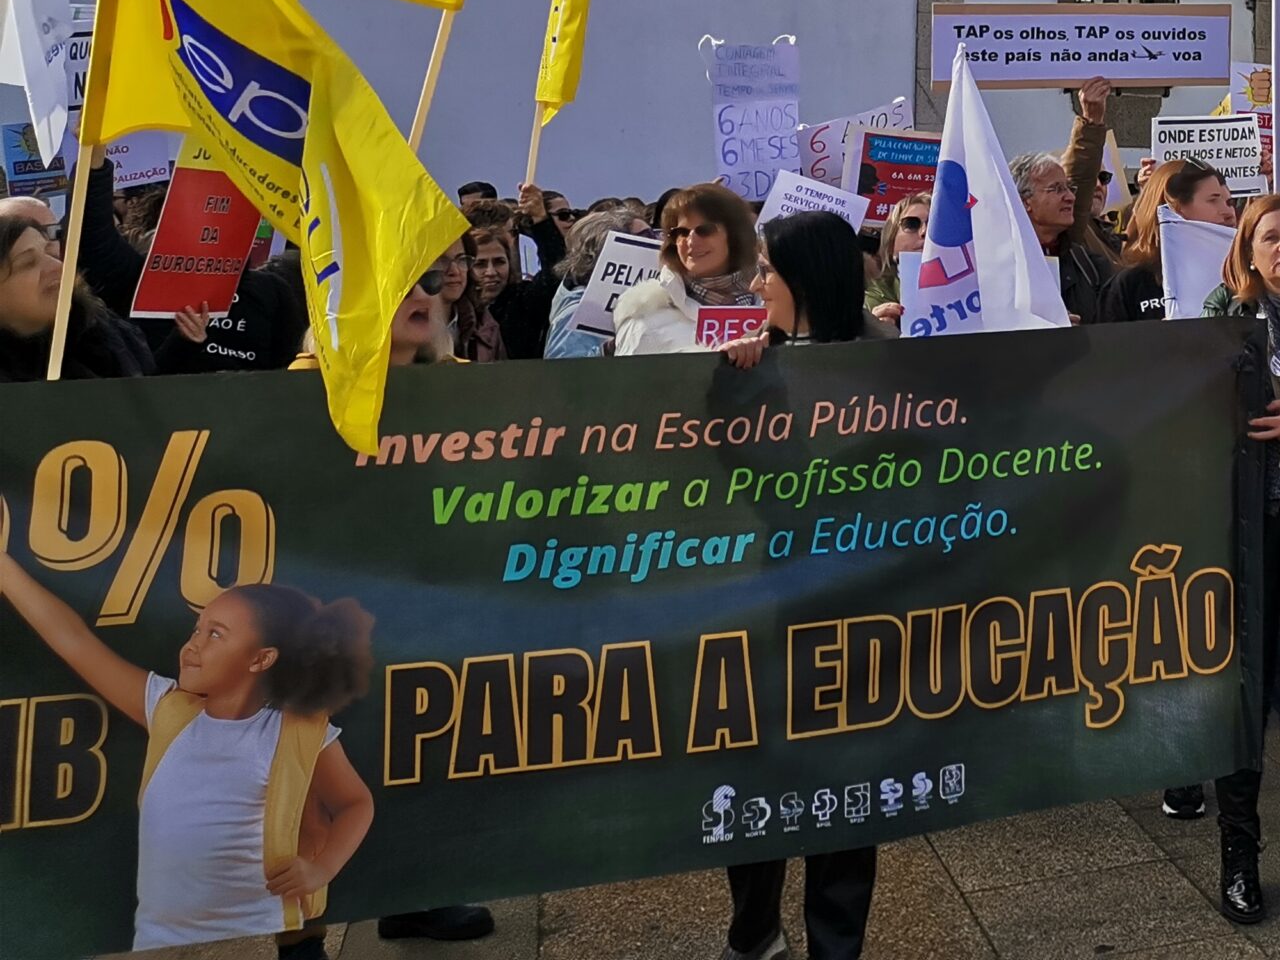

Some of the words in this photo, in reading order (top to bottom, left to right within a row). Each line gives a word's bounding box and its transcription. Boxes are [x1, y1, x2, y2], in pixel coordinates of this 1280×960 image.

[953, 25, 990, 39] TAP
[993, 29, 1014, 40] os
[1020, 26, 1070, 41] olhos,
[1074, 26, 1110, 39] TAP
[1116, 29, 1135, 41] os
[1141, 27, 1207, 41] ouvidos
[1005, 48, 1042, 64] país
[1050, 48, 1082, 62] não
[1087, 48, 1129, 62] anda
[1172, 50, 1201, 61] voa
[718, 104, 735, 136] 6
[738, 103, 796, 131] ANOS
[810, 125, 830, 154] 6
[1158, 130, 1195, 144] ONDE
[1199, 127, 1256, 143] ESTUDAM
[105, 145, 129, 156] NÃO
[722, 137, 738, 166] 6
[740, 134, 799, 161] MESES
[1164, 150, 1178, 161] OS
[1180, 148, 1214, 162] FILHOS
[1216, 149, 1223, 159] E
[1224, 146, 1257, 158] NETOS
[811, 156, 831, 178] 6
[891, 171, 904, 180] 6A
[204, 195, 231, 214] FIM
[783, 192, 821, 211] SERVIÇO
[804, 187, 834, 204] TEMPO
[835, 198, 847, 208] DE
[200, 226, 220, 244] DA
[149, 254, 244, 275] BUROCRACIA
[580, 422, 637, 453] na
[654, 404, 793, 450] Escola
[809, 392, 967, 438] Pública.
[432, 475, 670, 525] Valorizar
[683, 477, 710, 508] a
[726, 452, 922, 508] Profissão
[938, 440, 1102, 484] Docente.
[503, 529, 755, 589] Dignificar
[769, 527, 794, 559] a
[810, 501, 1017, 553] Educação.
[384, 641, 661, 786] PARA
[686, 629, 758, 754] A
[786, 543, 1235, 740] EDUCAÇÃO
